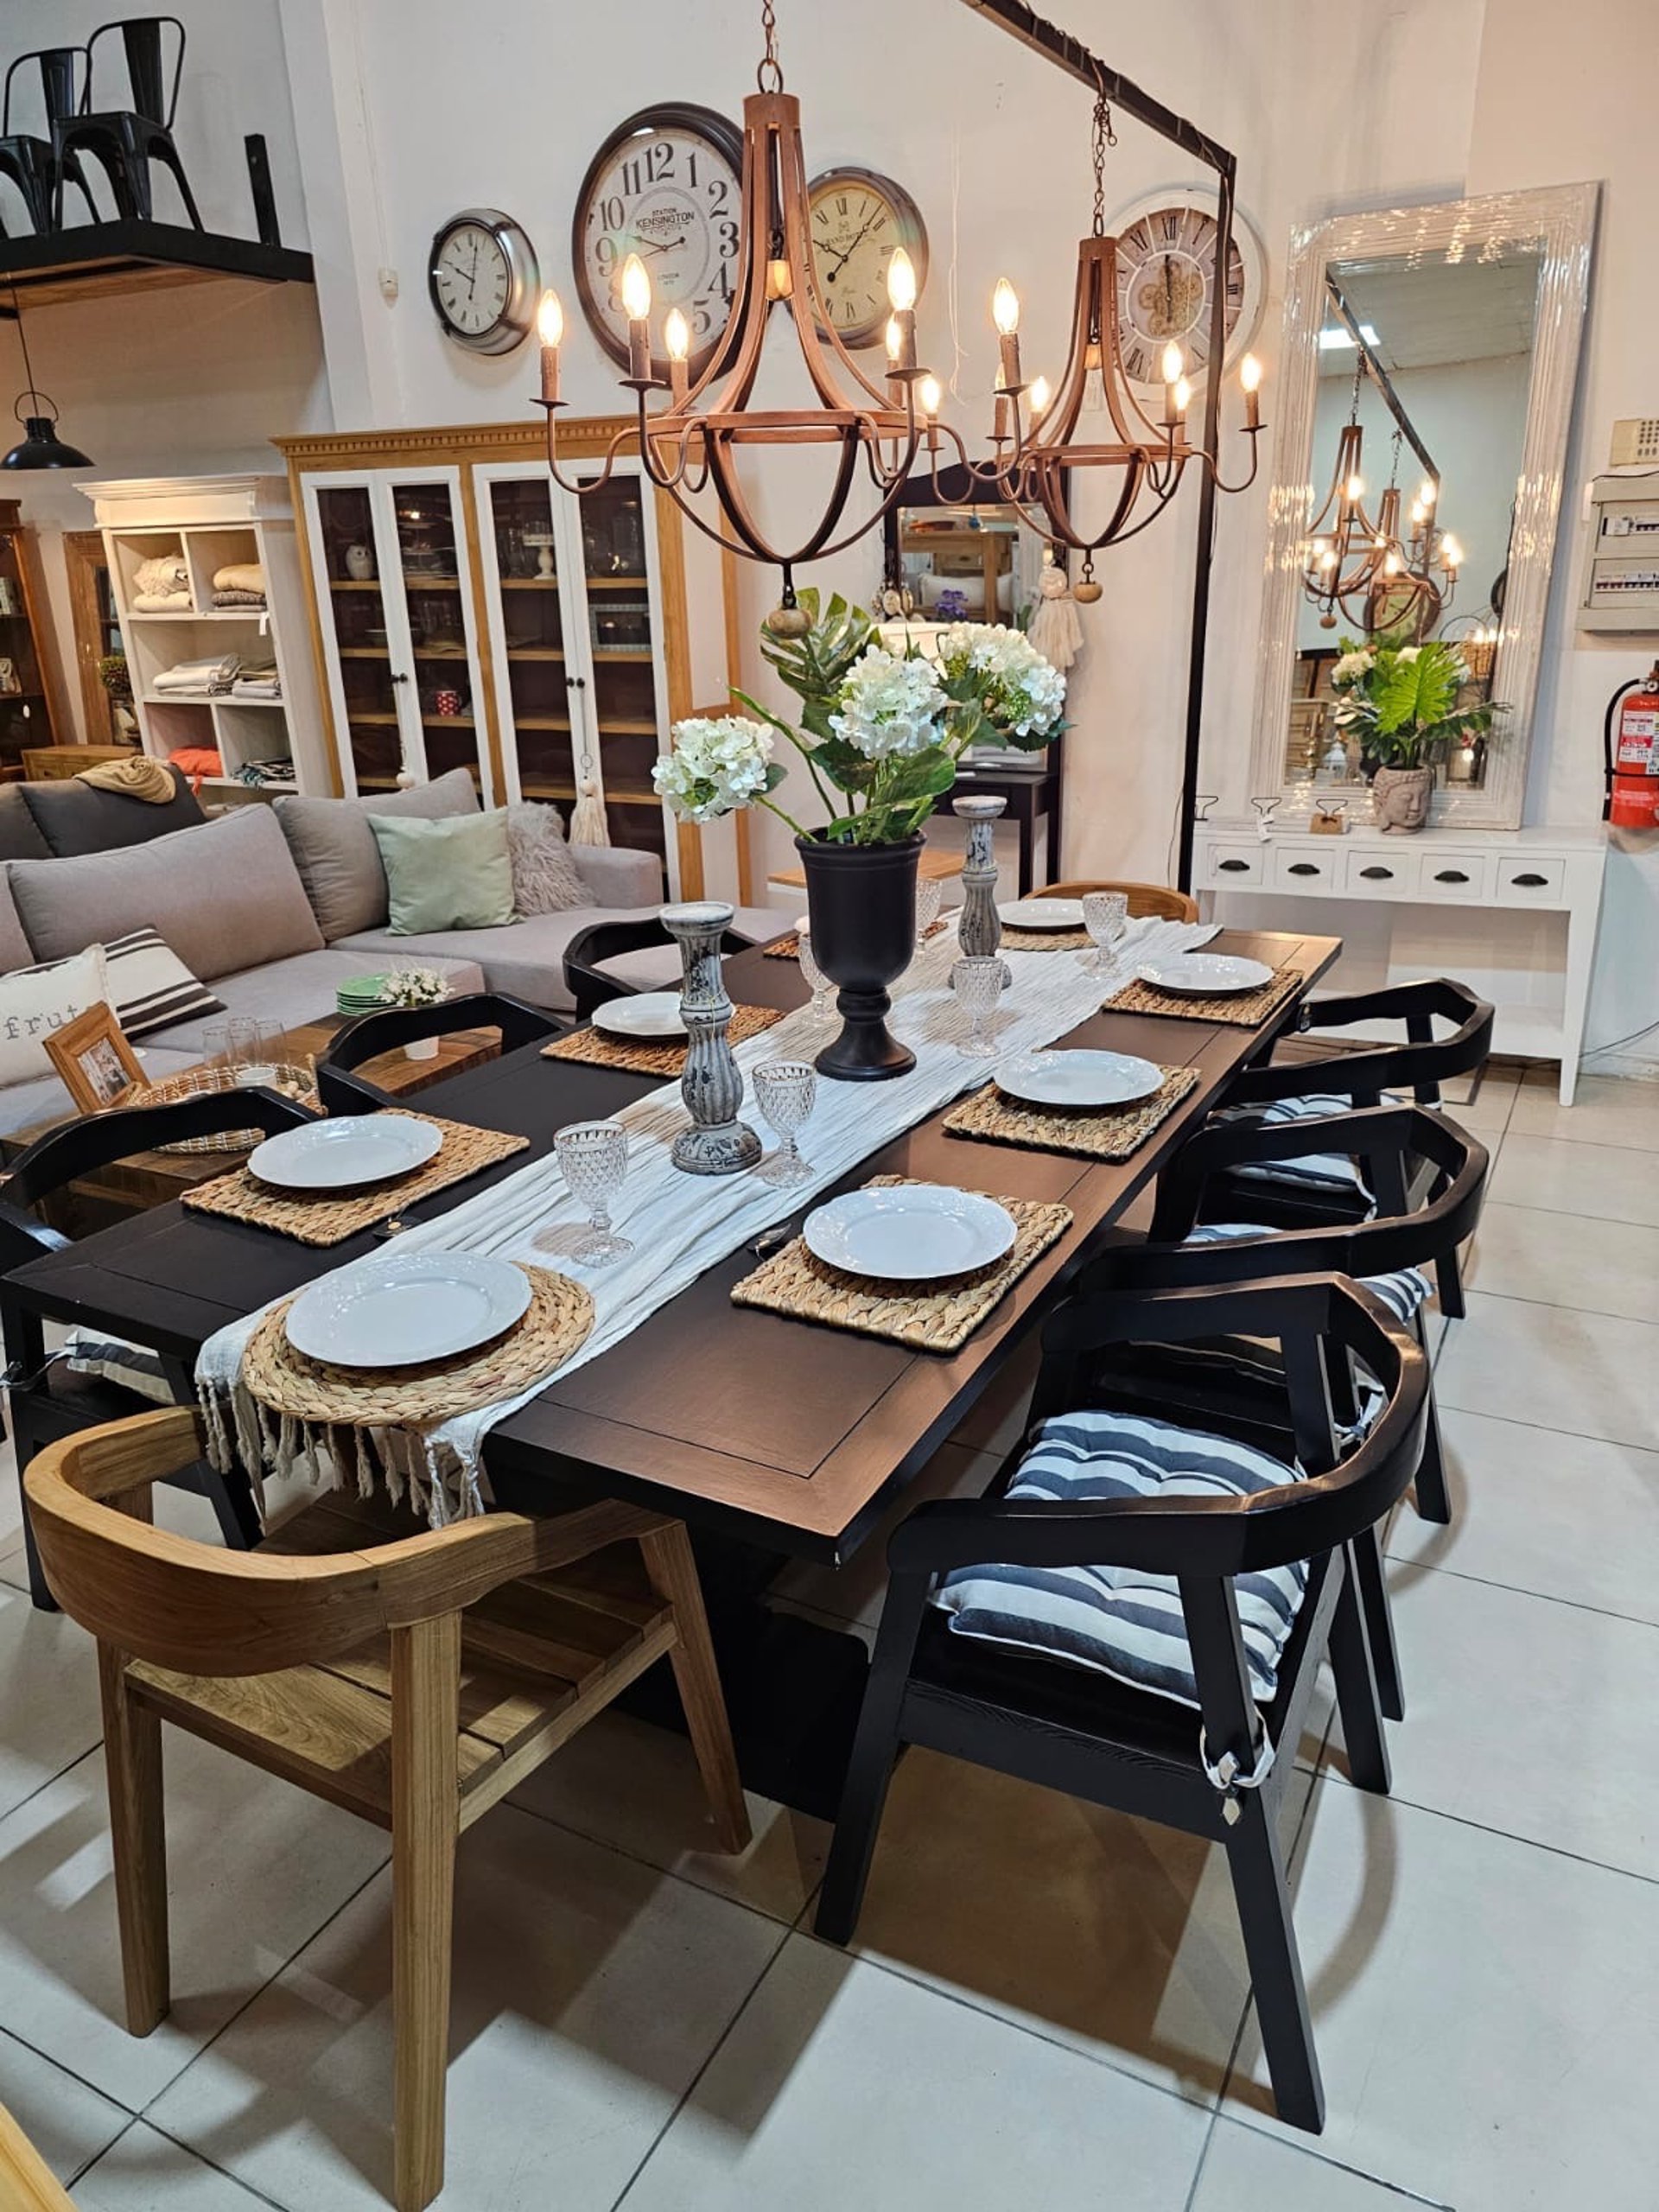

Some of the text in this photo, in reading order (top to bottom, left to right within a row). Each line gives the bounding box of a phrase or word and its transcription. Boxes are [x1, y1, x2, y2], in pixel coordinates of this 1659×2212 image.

[621, 160, 641, 196] 11
[643, 143, 675, 183] 12
[686, 152, 698, 188] 1
[600, 196, 625, 232] 10
[708, 181, 728, 219] 2
[636, 211, 695, 229] KENSINGTON
[595, 237, 619, 277] 9
[719, 221, 740, 258] 3
[708, 262, 733, 299] 4
[692, 299, 711, 335] 5
[3, 1004, 79, 1040] frut
